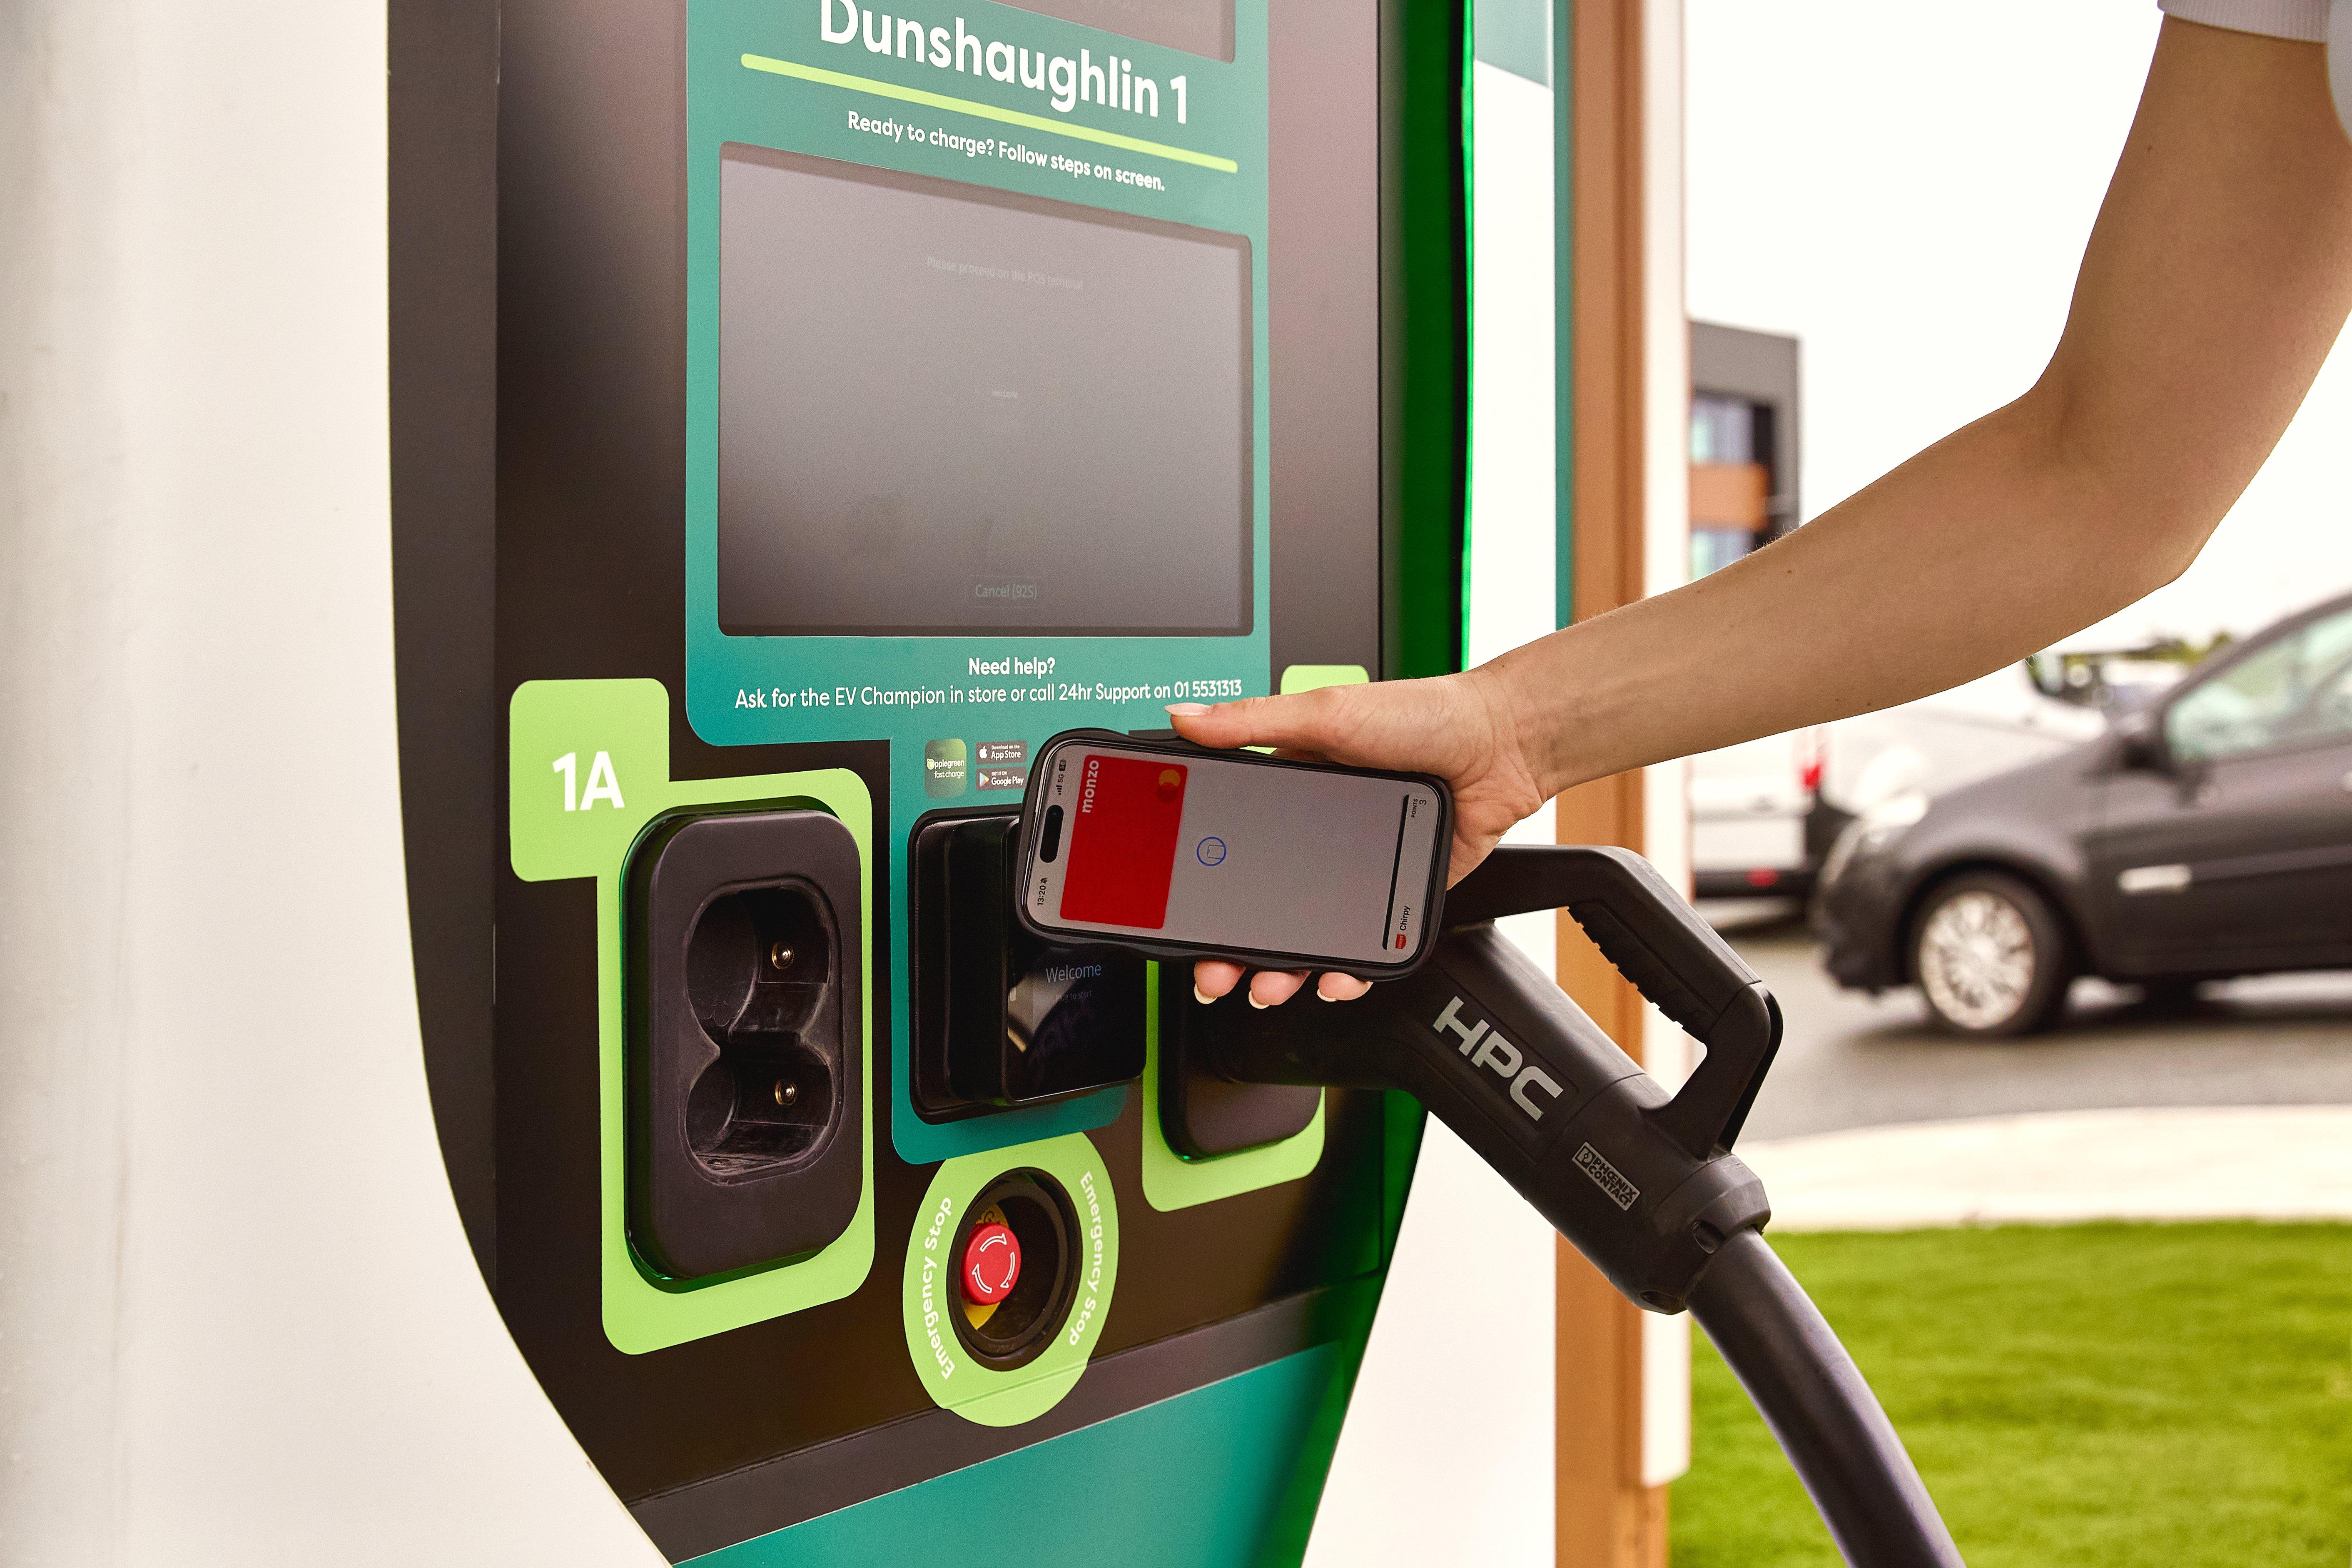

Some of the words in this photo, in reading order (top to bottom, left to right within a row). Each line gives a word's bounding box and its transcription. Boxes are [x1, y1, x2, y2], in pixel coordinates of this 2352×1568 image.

[821, 0, 1159, 118] Dunshaughlin
[1170, 75, 1187, 125] 1
[848, 110, 904, 143] Ready
[907, 123, 926, 142] to
[929, 127, 995, 158] charge?
[999, 140, 1048, 167] Follow
[1050, 154, 1091, 179] steps
[1094, 165, 1112, 181] on
[1115, 169, 1166, 192] screen.
[927, 256, 957, 271] Please
[959, 262, 996, 277] proceed
[997, 269, 1010, 279] on
[1011, 269, 1026, 282] the
[975, 583, 1010, 598] Cancel
[969, 657, 1010, 675] Need
[1014, 656, 1056, 680] help?
[735, 688, 767, 708] Ask
[771, 688, 797, 708] for
[800, 687, 830, 707] the
[835, 687, 857, 706] EV
[861, 685, 945, 709] Champion
[950, 685, 964, 703] in
[968, 686, 1007, 703] store
[1010, 688, 1027, 702] or
[1029, 683, 1054, 701] call
[1059, 683, 1093, 700] 24hr
[1095, 683, 1151, 705] Support
[1154, 686, 1171, 699] on
[1174, 681, 1189, 698] 01
[1192, 679, 1242, 698] 5531313
[991, 751, 1004, 760] App
[1004, 750, 1021, 758] Store
[552, 751, 625, 811] 1A
[945, 770, 965, 779] charge
[991, 777, 1012, 787] Google
[1012, 776, 1024, 786] Play
[1057, 774, 1064, 783] 5G
[1082, 760, 1100, 813] monzo
[1037, 885, 1046, 906] 13:20
[1400, 905, 1411, 931] Chirpy
[1046, 964, 1101, 983] Welcome
[1078, 990, 1092, 999] start
[1432, 995, 1565, 1122] HPC
[1588, 1165, 1632, 1206] CONTACT
[924, 1197, 952, 1251] Stop
[1079, 1171, 1104, 1293] Emergency
[922, 1256, 955, 1379] Emergency
[1069, 1296, 1096, 1346] Stop
